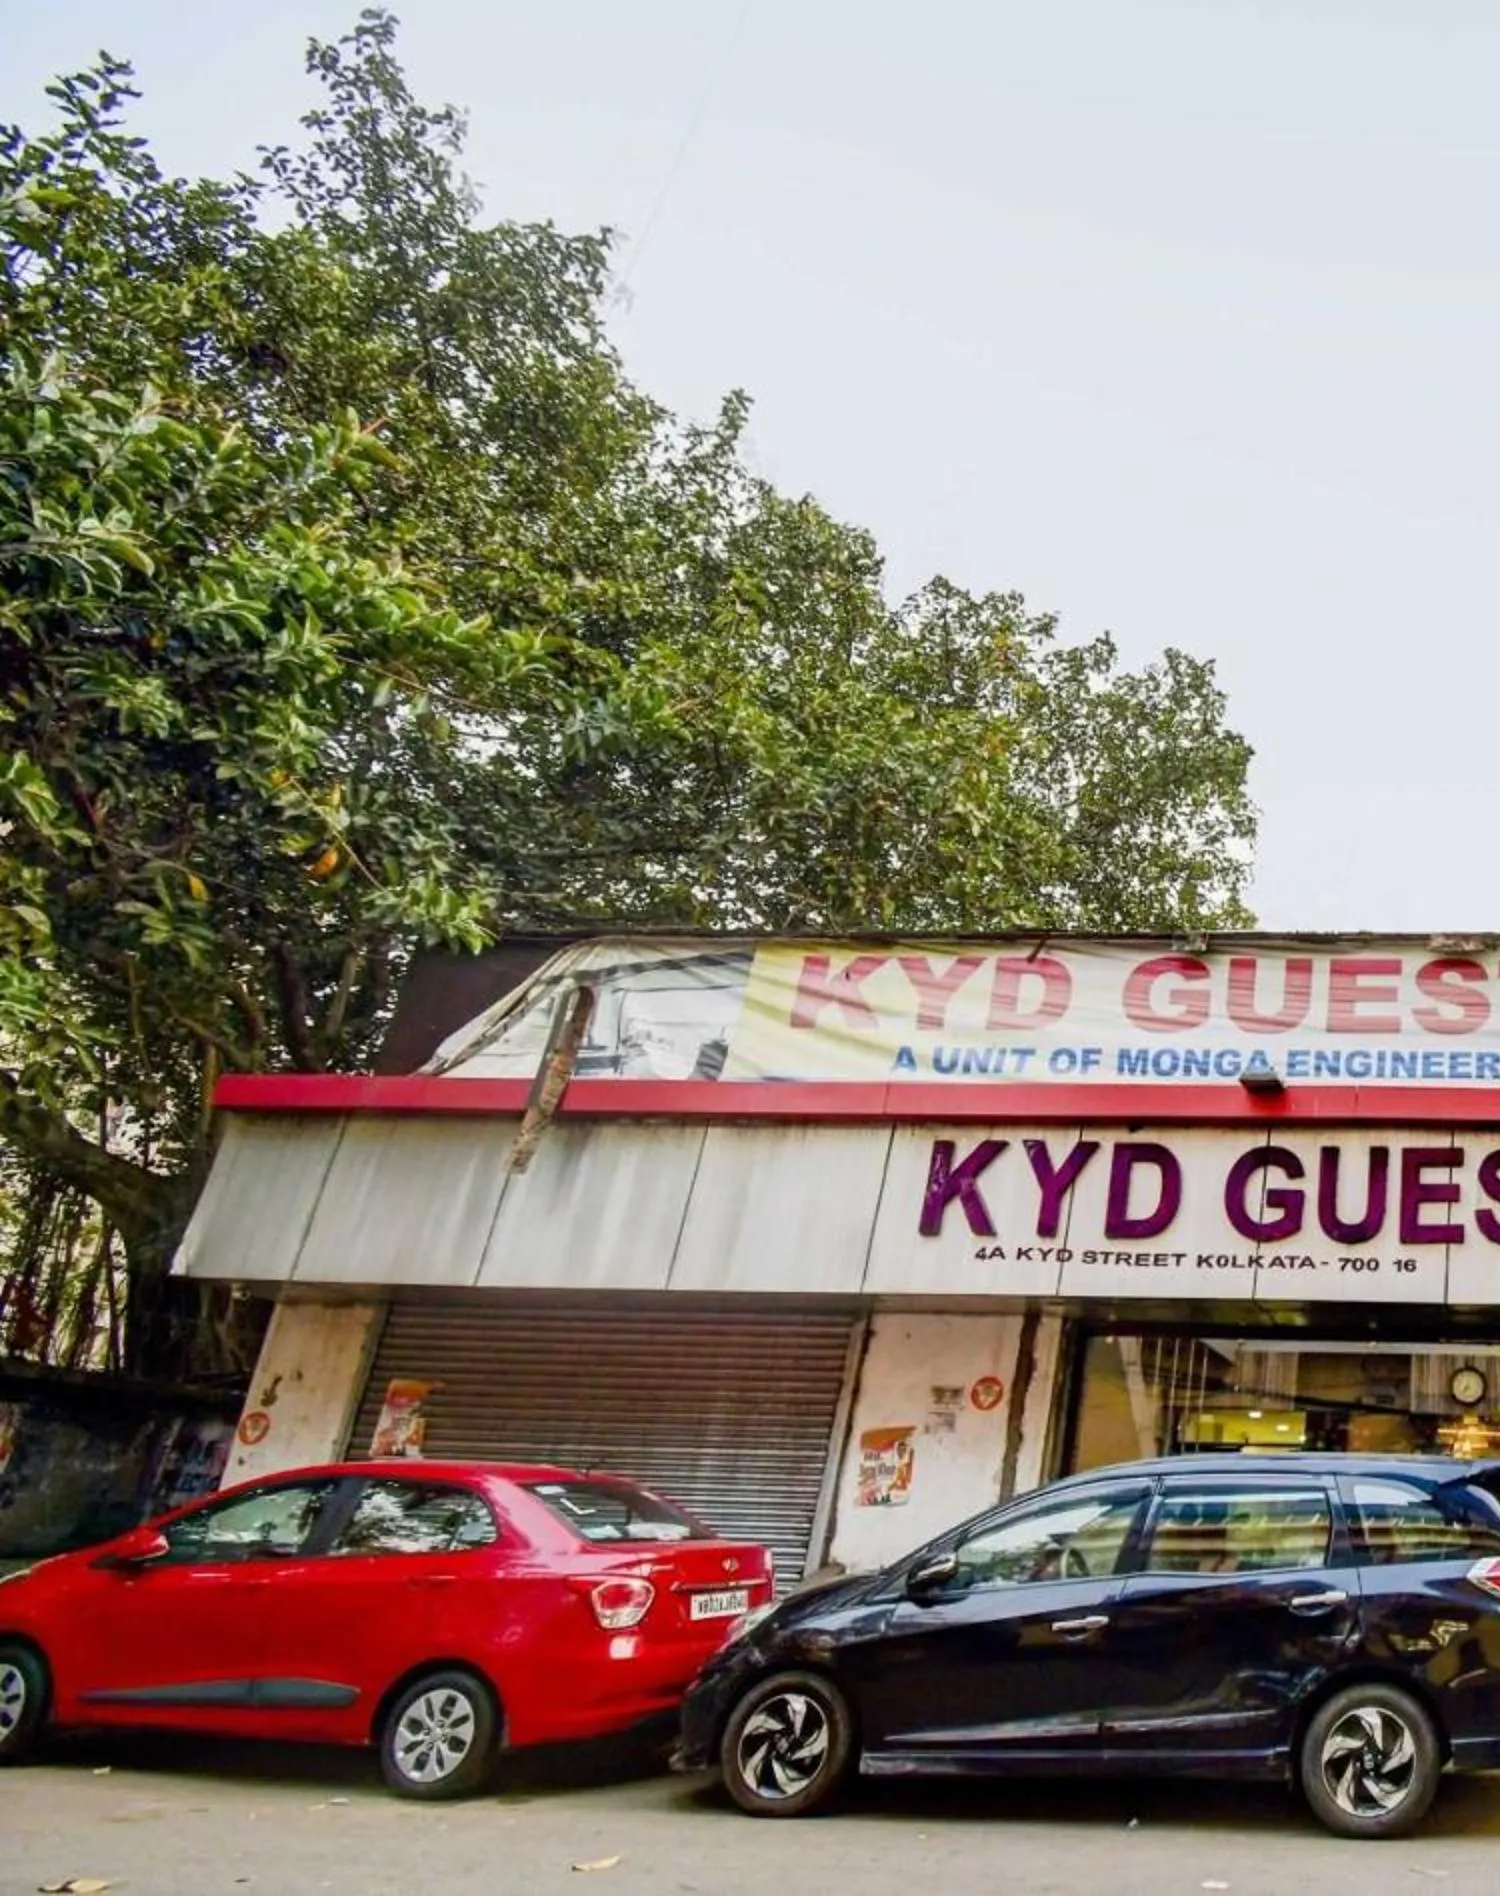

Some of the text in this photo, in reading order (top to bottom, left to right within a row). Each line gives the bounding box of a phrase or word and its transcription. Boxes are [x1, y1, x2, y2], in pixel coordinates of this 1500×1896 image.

[789, 955, 1074, 1031] KYD
[891, 1045, 918, 1072] A
[931, 1047, 1035, 1074] UNIT
[1048, 1047, 1103, 1075] OF
[1116, 1048, 1275, 1077] MONGA
[917, 1139, 1183, 1241] KYD
[974, 1247, 1006, 1261] 4A
[1016, 1247, 1073, 1263] KYD
[1082, 1250, 1187, 1268] STREET
[1338, 1257, 1380, 1273] 700
[1393, 1258, 1418, 1273] 16
